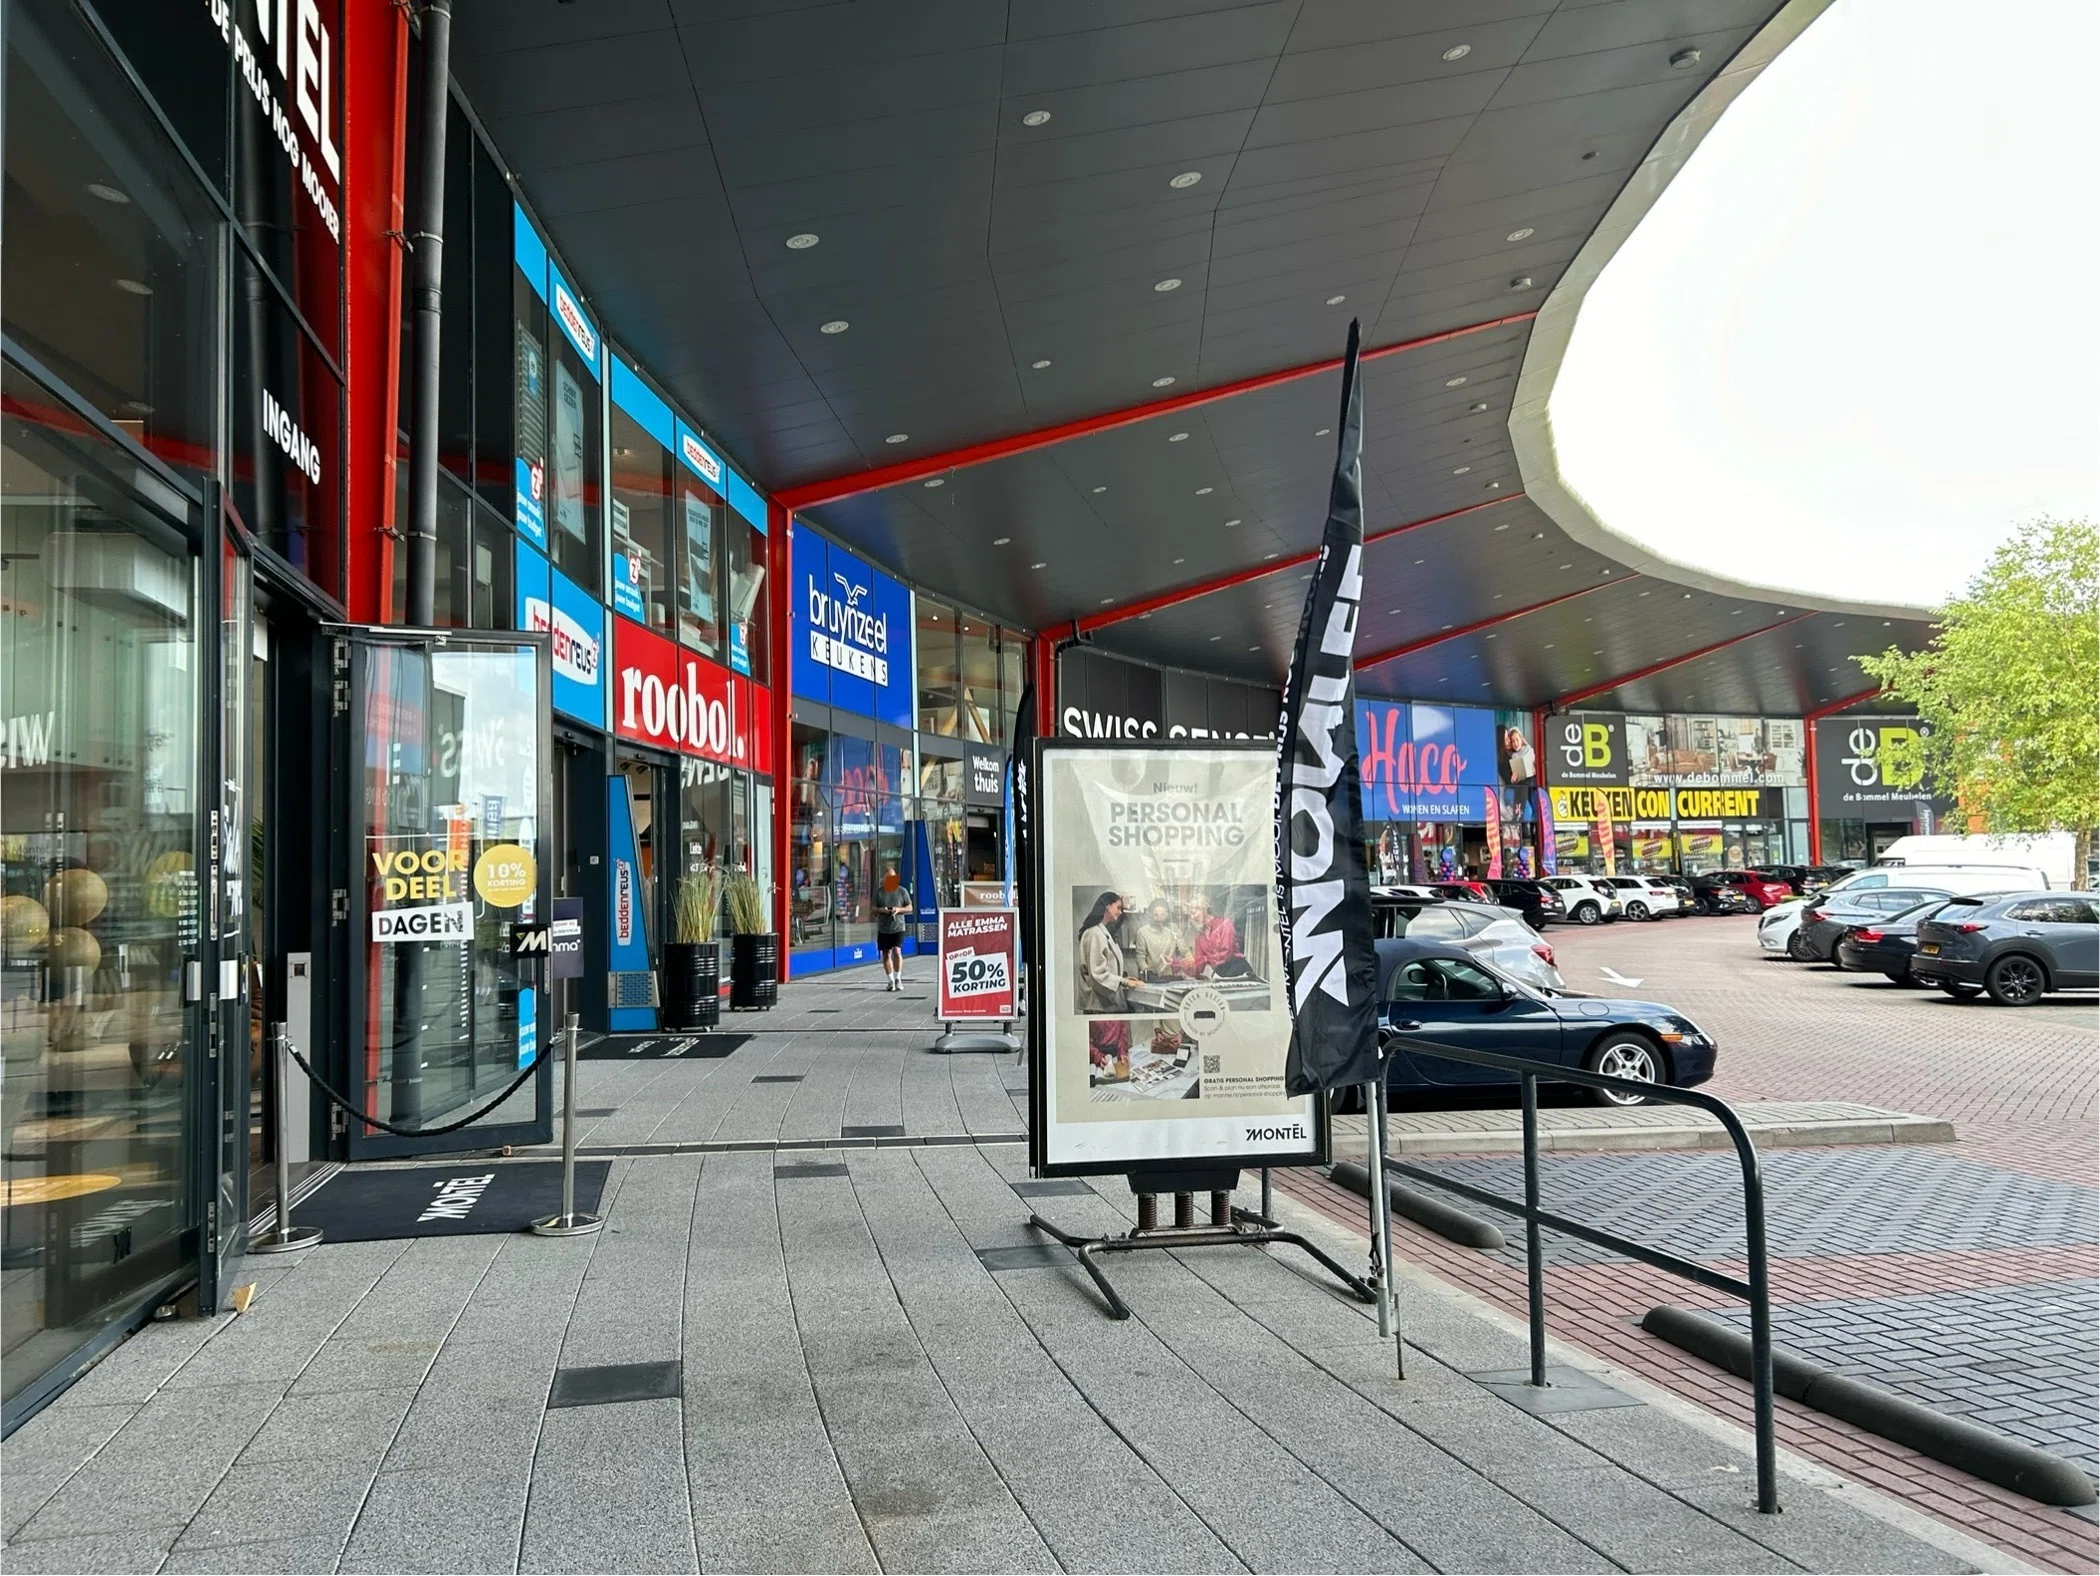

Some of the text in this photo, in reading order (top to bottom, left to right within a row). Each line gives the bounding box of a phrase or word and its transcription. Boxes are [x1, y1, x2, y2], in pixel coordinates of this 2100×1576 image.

[257, 0, 340, 184] TEL
[234, 24, 270, 116] PRIJS
[272, 97, 300, 168] NOG
[301, 151, 340, 246] MOOIER
[262, 387, 321, 485] INGANG
[809, 573, 888, 655] bruynzeel
[532, 604, 592, 676] bedenreus
[812, 634, 888, 684] KEUKENS
[972, 755, 1000, 773] Welkom
[1361, 708, 1468, 814] Haco
[973, 772, 999, 794] thuis
[1152, 782, 1198, 794] Nieuw!
[1653, 771, 1785, 785] www.debommel.com
[1637, 790, 1671, 819] CON
[1676, 789, 1760, 818] CURRENT
[1843, 793, 1854, 801] de
[1891, 791, 1932, 801] Meubelen
[1110, 802, 1243, 824] PERSONAL
[1430, 804, 1440, 815] EN
[1108, 825, 1244, 848] SHOPPING
[372, 849, 469, 876] VOOR
[487, 862, 527, 880] 10%
[386, 875, 457, 901] DEEL
[487, 879, 527, 888] KORTING
[980, 889, 1019, 900] roobl.
[618, 868, 630, 939] beddenreus
[378, 910, 464, 936] DAGEN
[947, 923, 1008, 938] MATRASSEN
[948, 915, 1006, 930] ALLE EMMA
[951, 959, 1005, 984] 50%
[953, 978, 1006, 993] KORTING
